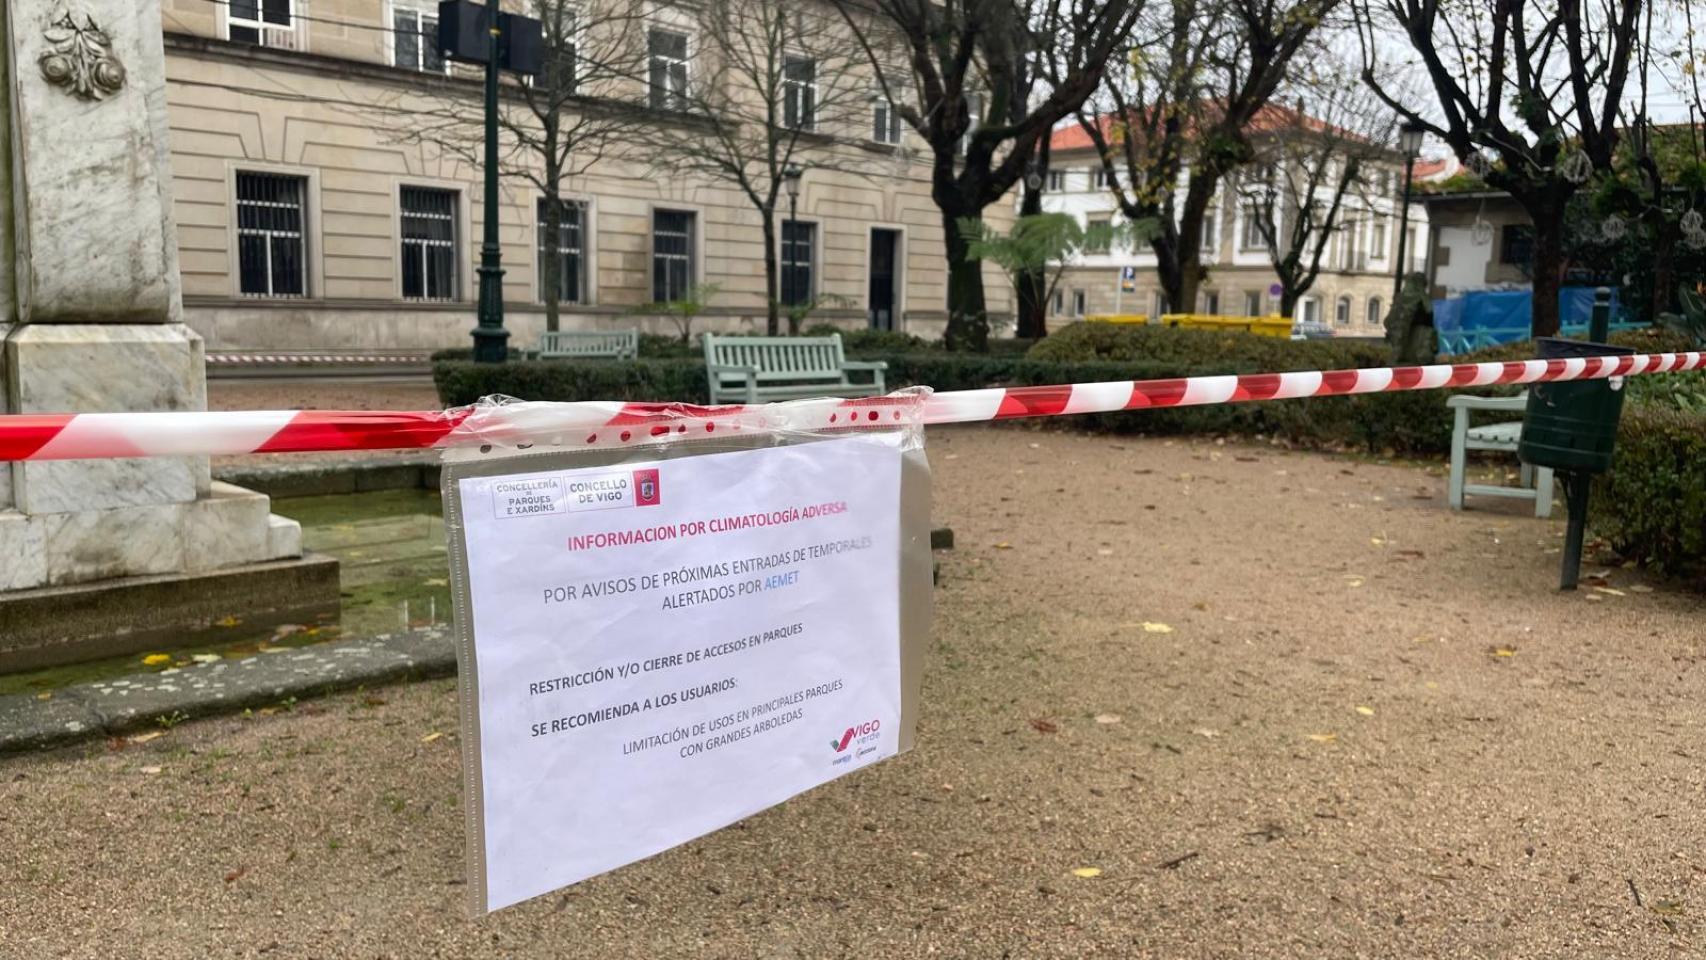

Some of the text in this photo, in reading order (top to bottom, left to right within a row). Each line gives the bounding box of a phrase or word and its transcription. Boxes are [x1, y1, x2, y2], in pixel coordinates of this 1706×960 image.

[496, 479, 558, 492] CONCELLERÍA
[570, 479, 627, 493] CONCELLO
[580, 492, 622, 504] DE VIGO
[508, 496, 550, 506] PARQUES
[516, 503, 554, 514] XARDÍNS
[568, 501, 847, 552] INFORMACION POR CLIMATOLOGÍA ADVERSA
[544, 536, 872, 604] POR AVISOS DE PRÓXIMAS ENTRADAS DE TEMPORALES
[662, 570, 800, 610] ALERTADOS POR AEMET
[530, 622, 803, 696] RESTRICCIÓN Y/O CIERRE DE ACCESOS EN PARQUES
[531, 676, 738, 737] SE RECOMIENDA A LOS USUARIOS:
[623, 678, 844, 755] LIMITACIÓN DE USOS EN PRINCIPALES PARQUES
[680, 708, 804, 758] CON GRANDES ARBOLEDAS
[850, 719, 880, 738] VIGO
[856, 732, 880, 744] verde
